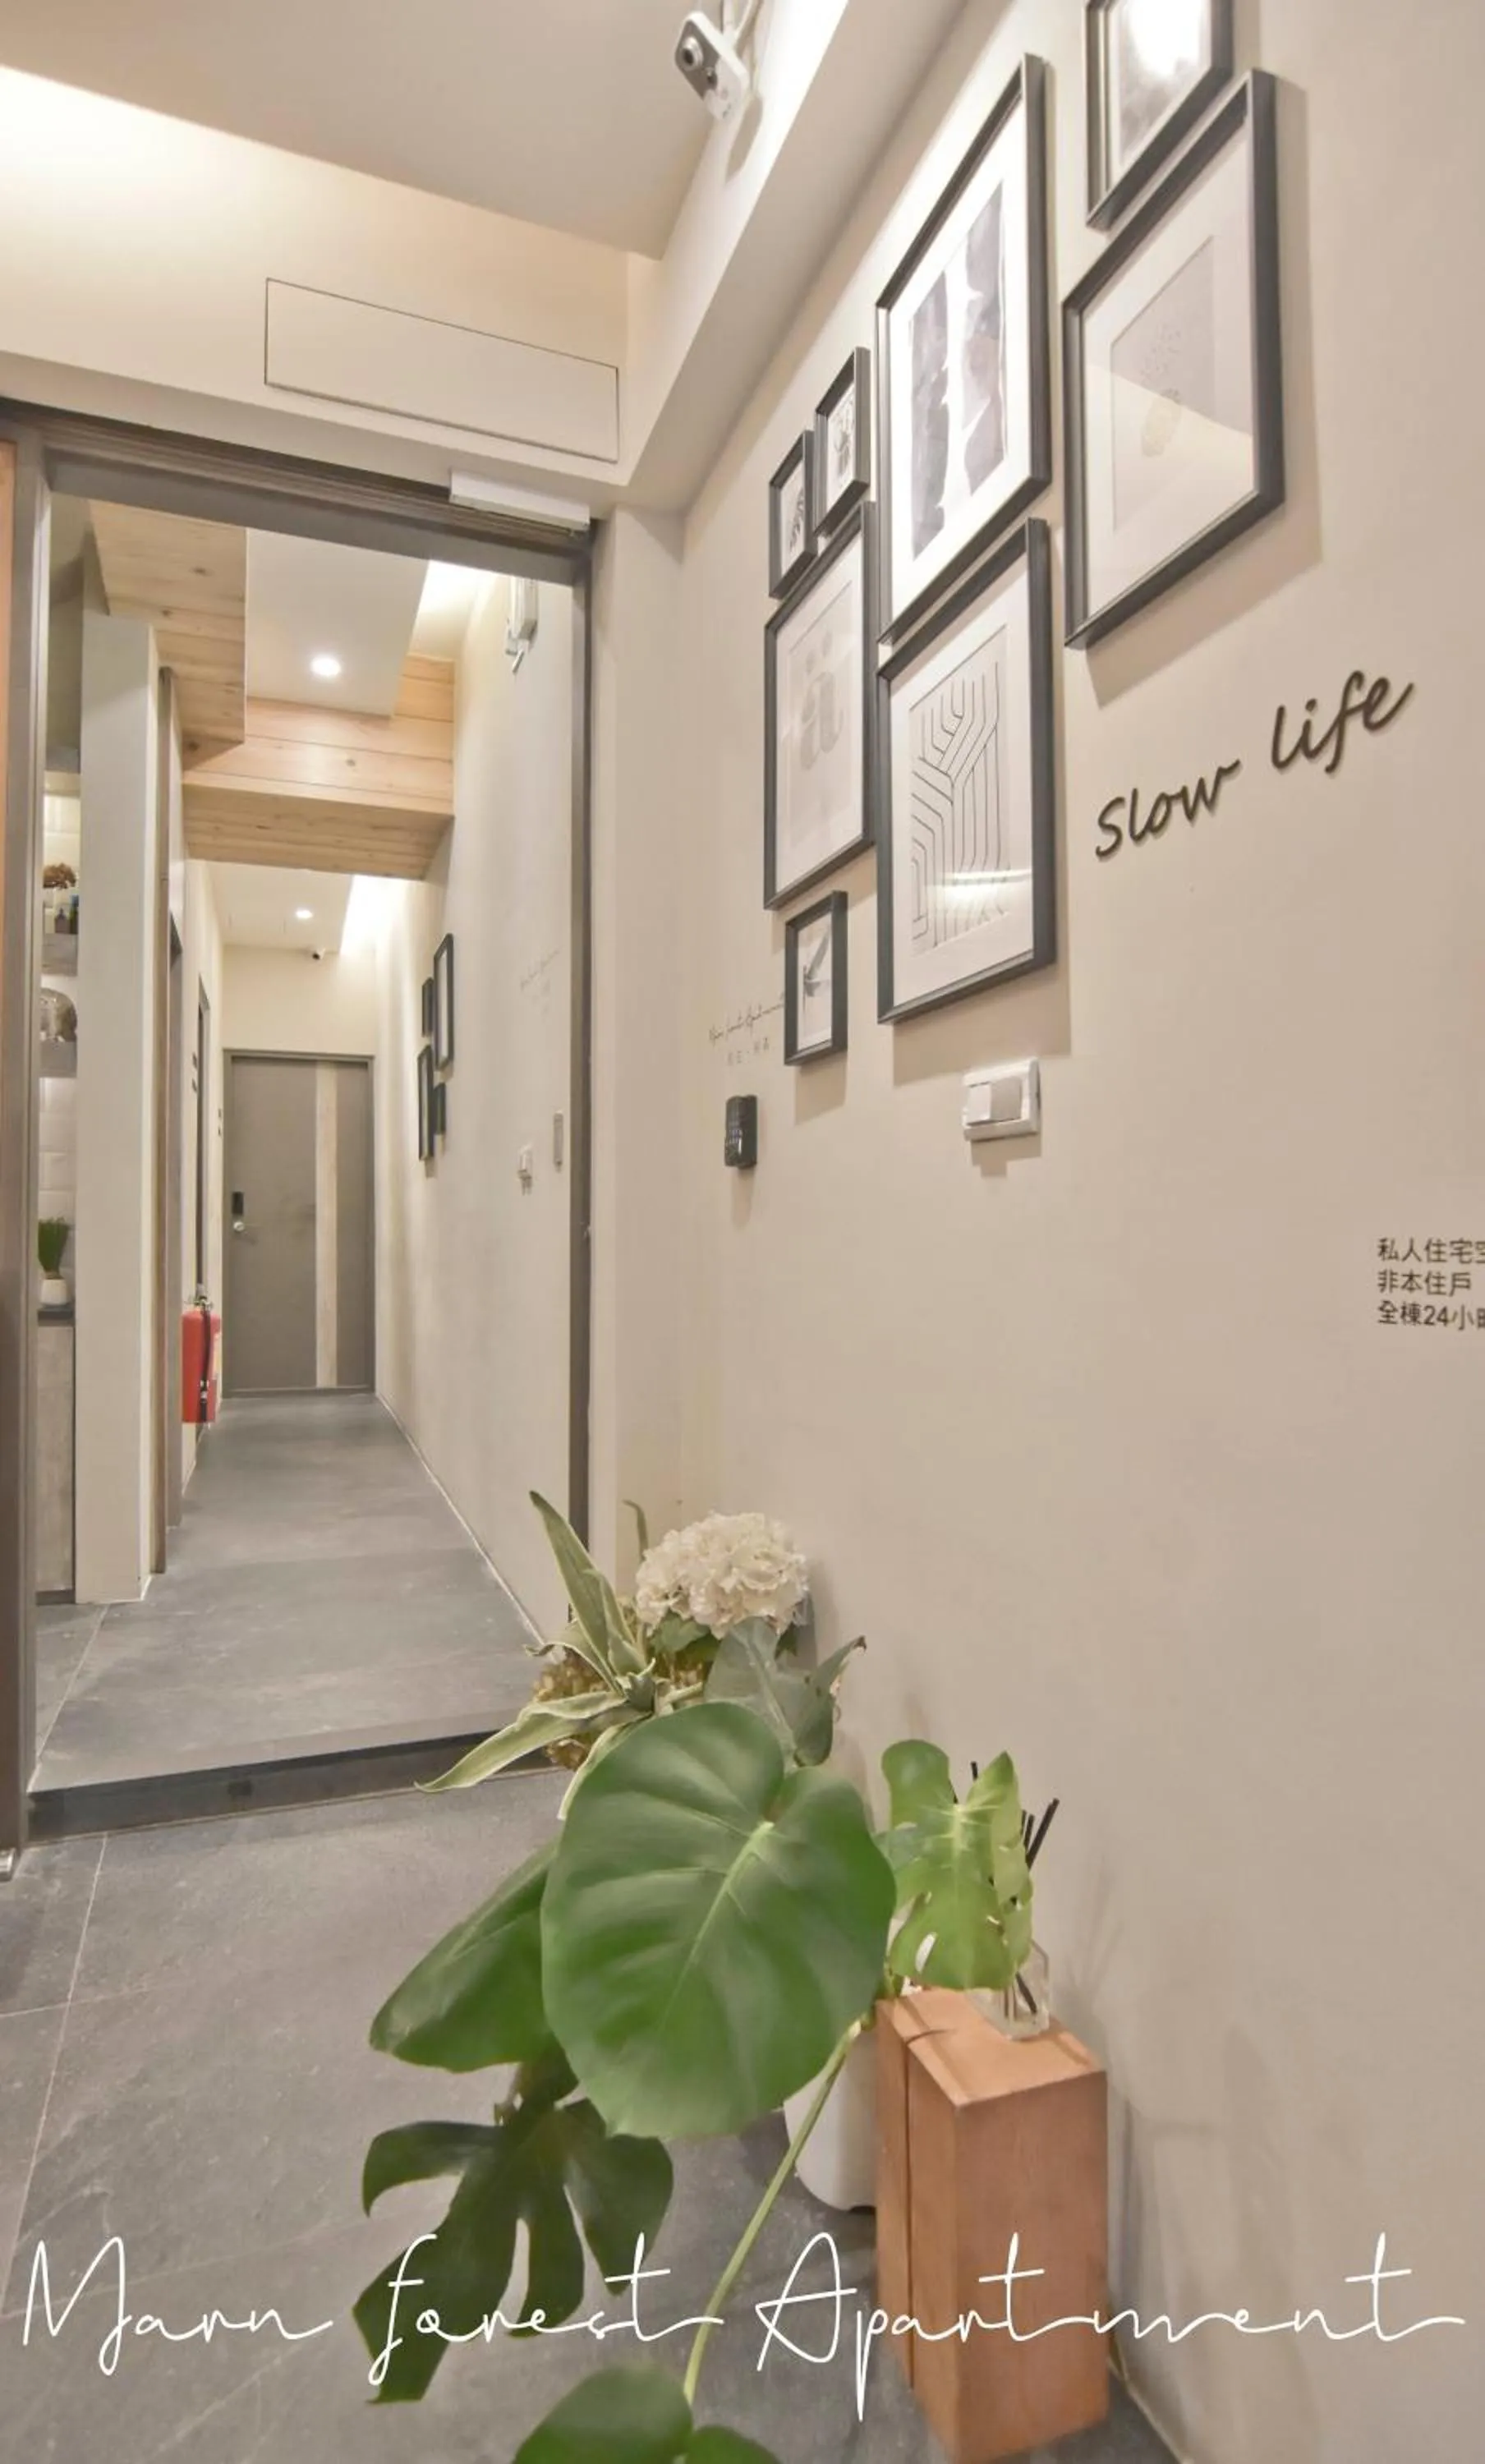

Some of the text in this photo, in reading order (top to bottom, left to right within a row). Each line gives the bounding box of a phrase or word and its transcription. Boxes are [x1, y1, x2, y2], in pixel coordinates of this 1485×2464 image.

[1095, 669, 1414, 859] Slow life
[1377, 1269, 1471, 1297] 非本住戶
